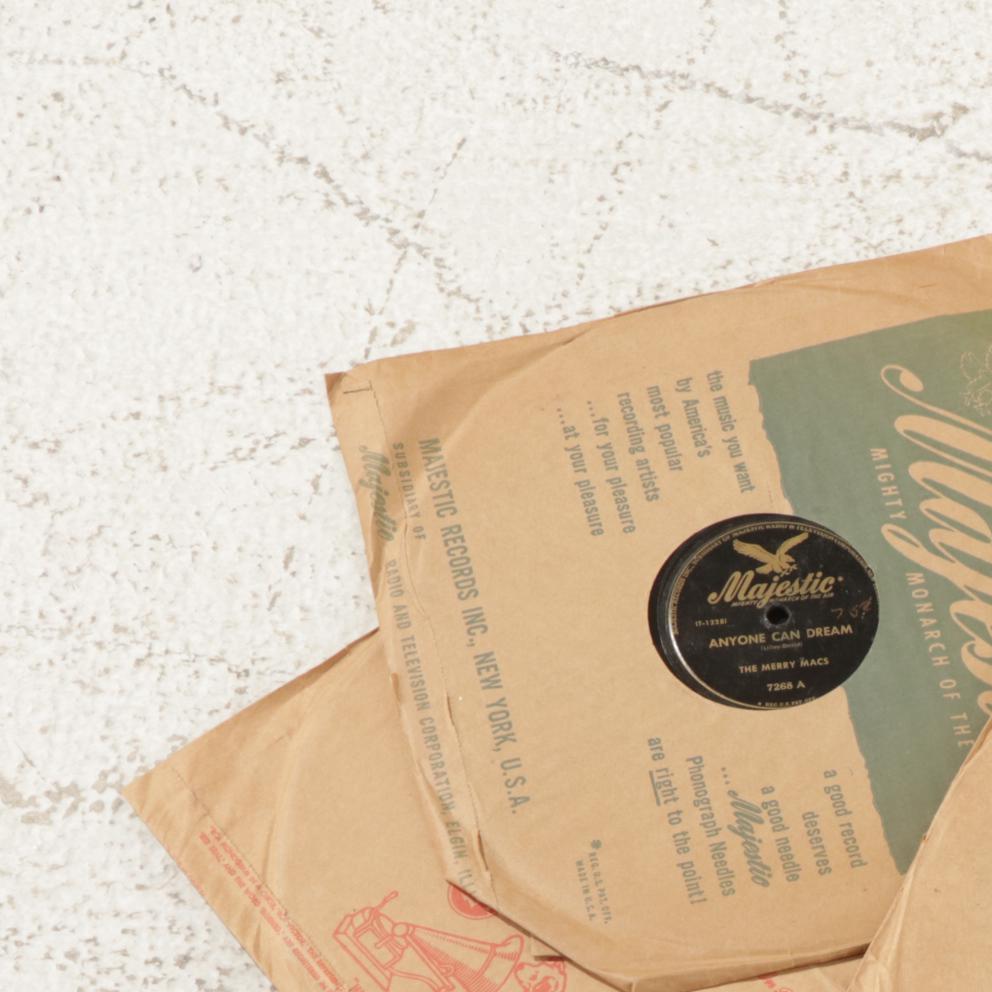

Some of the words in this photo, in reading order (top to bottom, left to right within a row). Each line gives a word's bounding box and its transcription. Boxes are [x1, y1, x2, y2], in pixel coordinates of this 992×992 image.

[675, 377, 693, 393] by
[706, 370, 724, 392] the
[647, 385, 671, 418] most
[713, 395, 736, 432] music
[617, 392, 645, 455] recording
[635, 458, 660, 502] artists
[654, 424, 683, 471] popular
[681, 399, 711, 458] America's
[722, 436, 743, 458] you
[564, 444, 587, 474] your
[596, 442, 619, 472] your
[359, 444, 398, 541] Majestic
[392, 442, 422, 519] SUBSIDIARY
[412, 526, 426, 540] OF
[418, 437, 459, 519] MAJESTIC
[733, 462, 756, 493] want
[869, 447, 908, 521] MIGHTY
[574, 479, 605, 536] pleasure
[605, 476, 636, 534] pleasure
[385, 559, 405, 598] RADIO
[440, 524, 479, 601] RECORDS
[707, 570, 836, 608] Majestic
[393, 604, 412, 630] AND
[461, 606, 488, 647] INC.,
[709, 633, 766, 649] ANYONE
[771, 630, 801, 642] CAN
[806, 624, 853, 638] DREAM
[905, 572, 950, 668] MONARCH
[401, 634, 431, 712] TELEVISION
[473, 651, 503, 691] NEW
[739, 664, 757, 674] THE
[761, 660, 796, 672] MERRY
[800, 657, 829, 668] MACS
[767, 681, 793, 691] 7268
[797, 680, 805, 689] A
[939, 678, 960, 700] OF
[486, 697, 517, 752] YORK,
[949, 712, 975, 748] THE
[647, 737, 665, 762] are
[500, 757, 531, 815] U.S.A.
[654, 766, 679, 805] right
[761, 785, 775, 796] a
[824, 769, 837, 779] a
[666, 809, 684, 825] to
[761, 799, 789, 833] good
[824, 784, 852, 818] good
[672, 829, 691, 856] the
[686, 755, 723, 838] Phonograph
[709, 841, 736, 897] Needles
[802, 811, 832, 876] deserves
[839, 822, 868, 868] record
[775, 837, 800, 882] needle
[677, 860, 707, 905] point!
